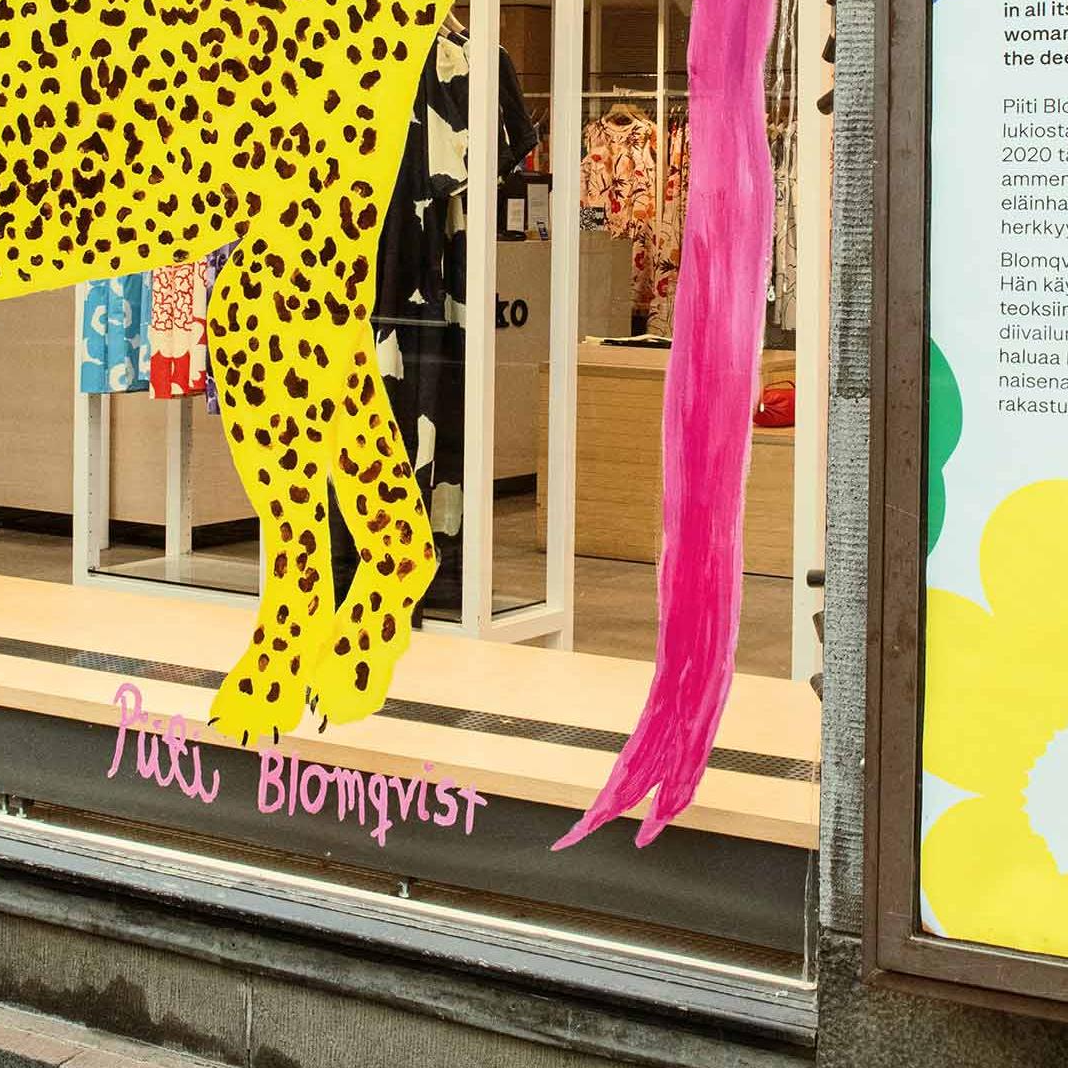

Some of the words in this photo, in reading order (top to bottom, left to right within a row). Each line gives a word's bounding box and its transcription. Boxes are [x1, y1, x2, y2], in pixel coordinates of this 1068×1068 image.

[1004, 2, 1019, 17] in
[1025, 1, 1046, 17] all
[1004, 50, 1035, 66] the
[1003, 98, 1037, 114] Piiti
[1002, 146, 1052, 162] 2020
[1059, 148, 1068, 162] t
[1001, 195, 1068, 211] eläinha
[1001, 219, 1068, 239] herkky
[1001, 276, 1037, 292] Hän
[1044, 276, 1068, 296] kä
[999, 324, 1068, 341] diivailu
[999, 348, 1060, 365] haluaa
[999, 373, 1068, 390] naisena
[998, 397, 1068, 414] rakastu
[257, 748, 488, 847] Blomqvist
